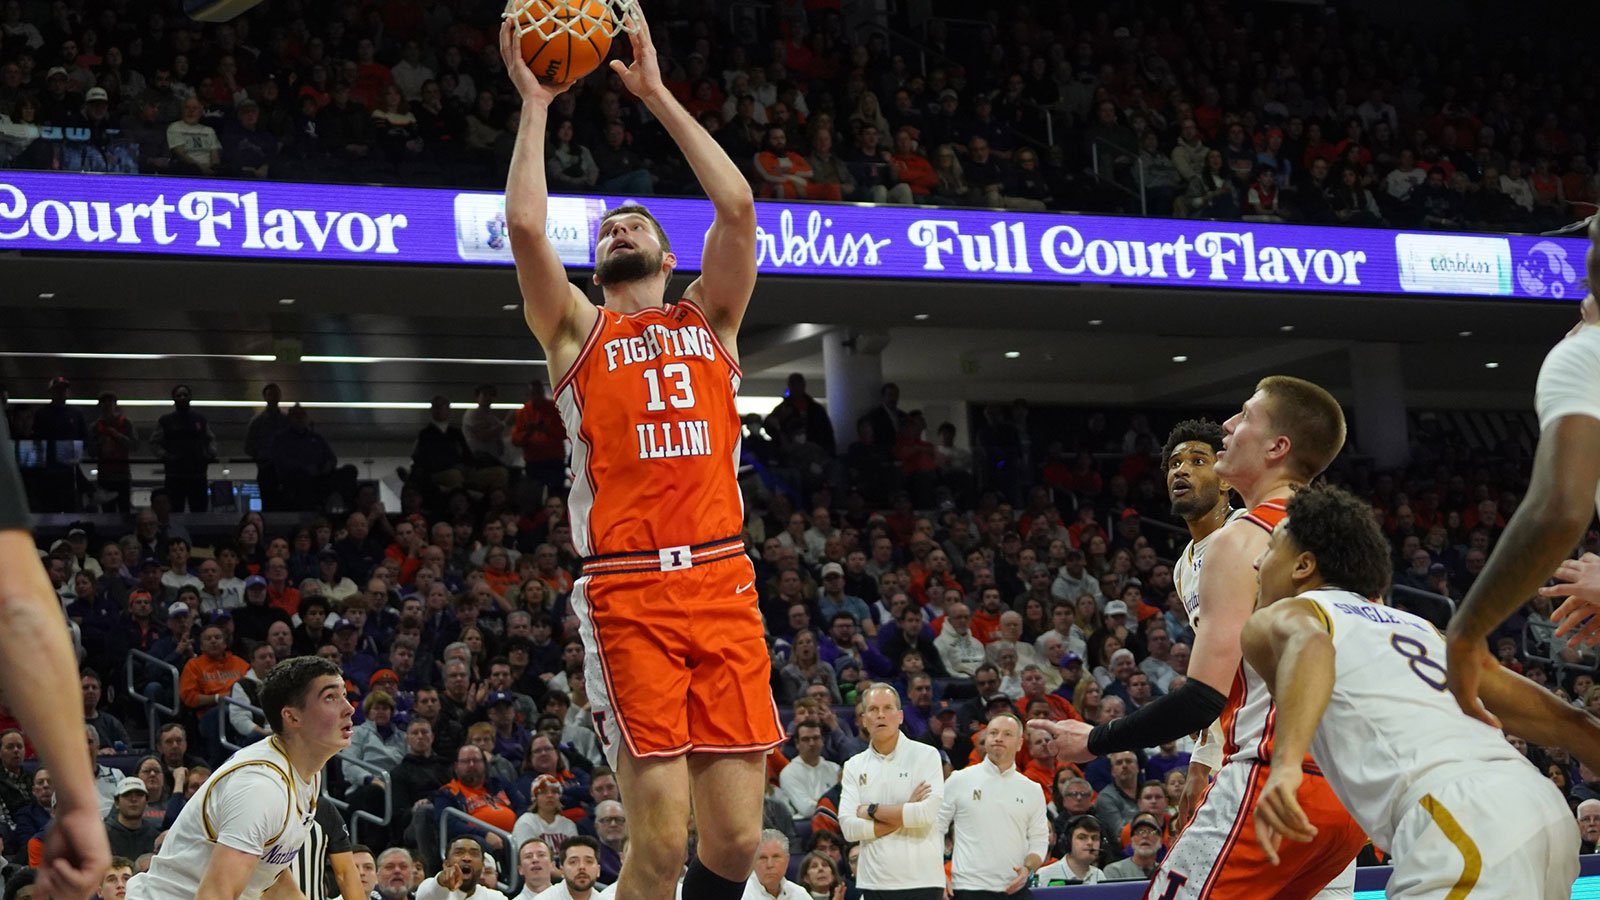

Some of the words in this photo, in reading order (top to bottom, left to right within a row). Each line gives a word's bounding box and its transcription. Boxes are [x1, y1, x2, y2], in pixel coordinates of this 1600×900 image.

[178, 191, 408, 253] Flavor
[908, 220, 1032, 273] Full
[1040, 225, 1195, 279] Court
[1195, 232, 1366, 285] Flavor
[604, 324, 716, 372] FIGHTING
[643, 362, 696, 411] 13
[636, 420, 712, 459] ILLINI
[1390, 632, 1448, 693] 8
